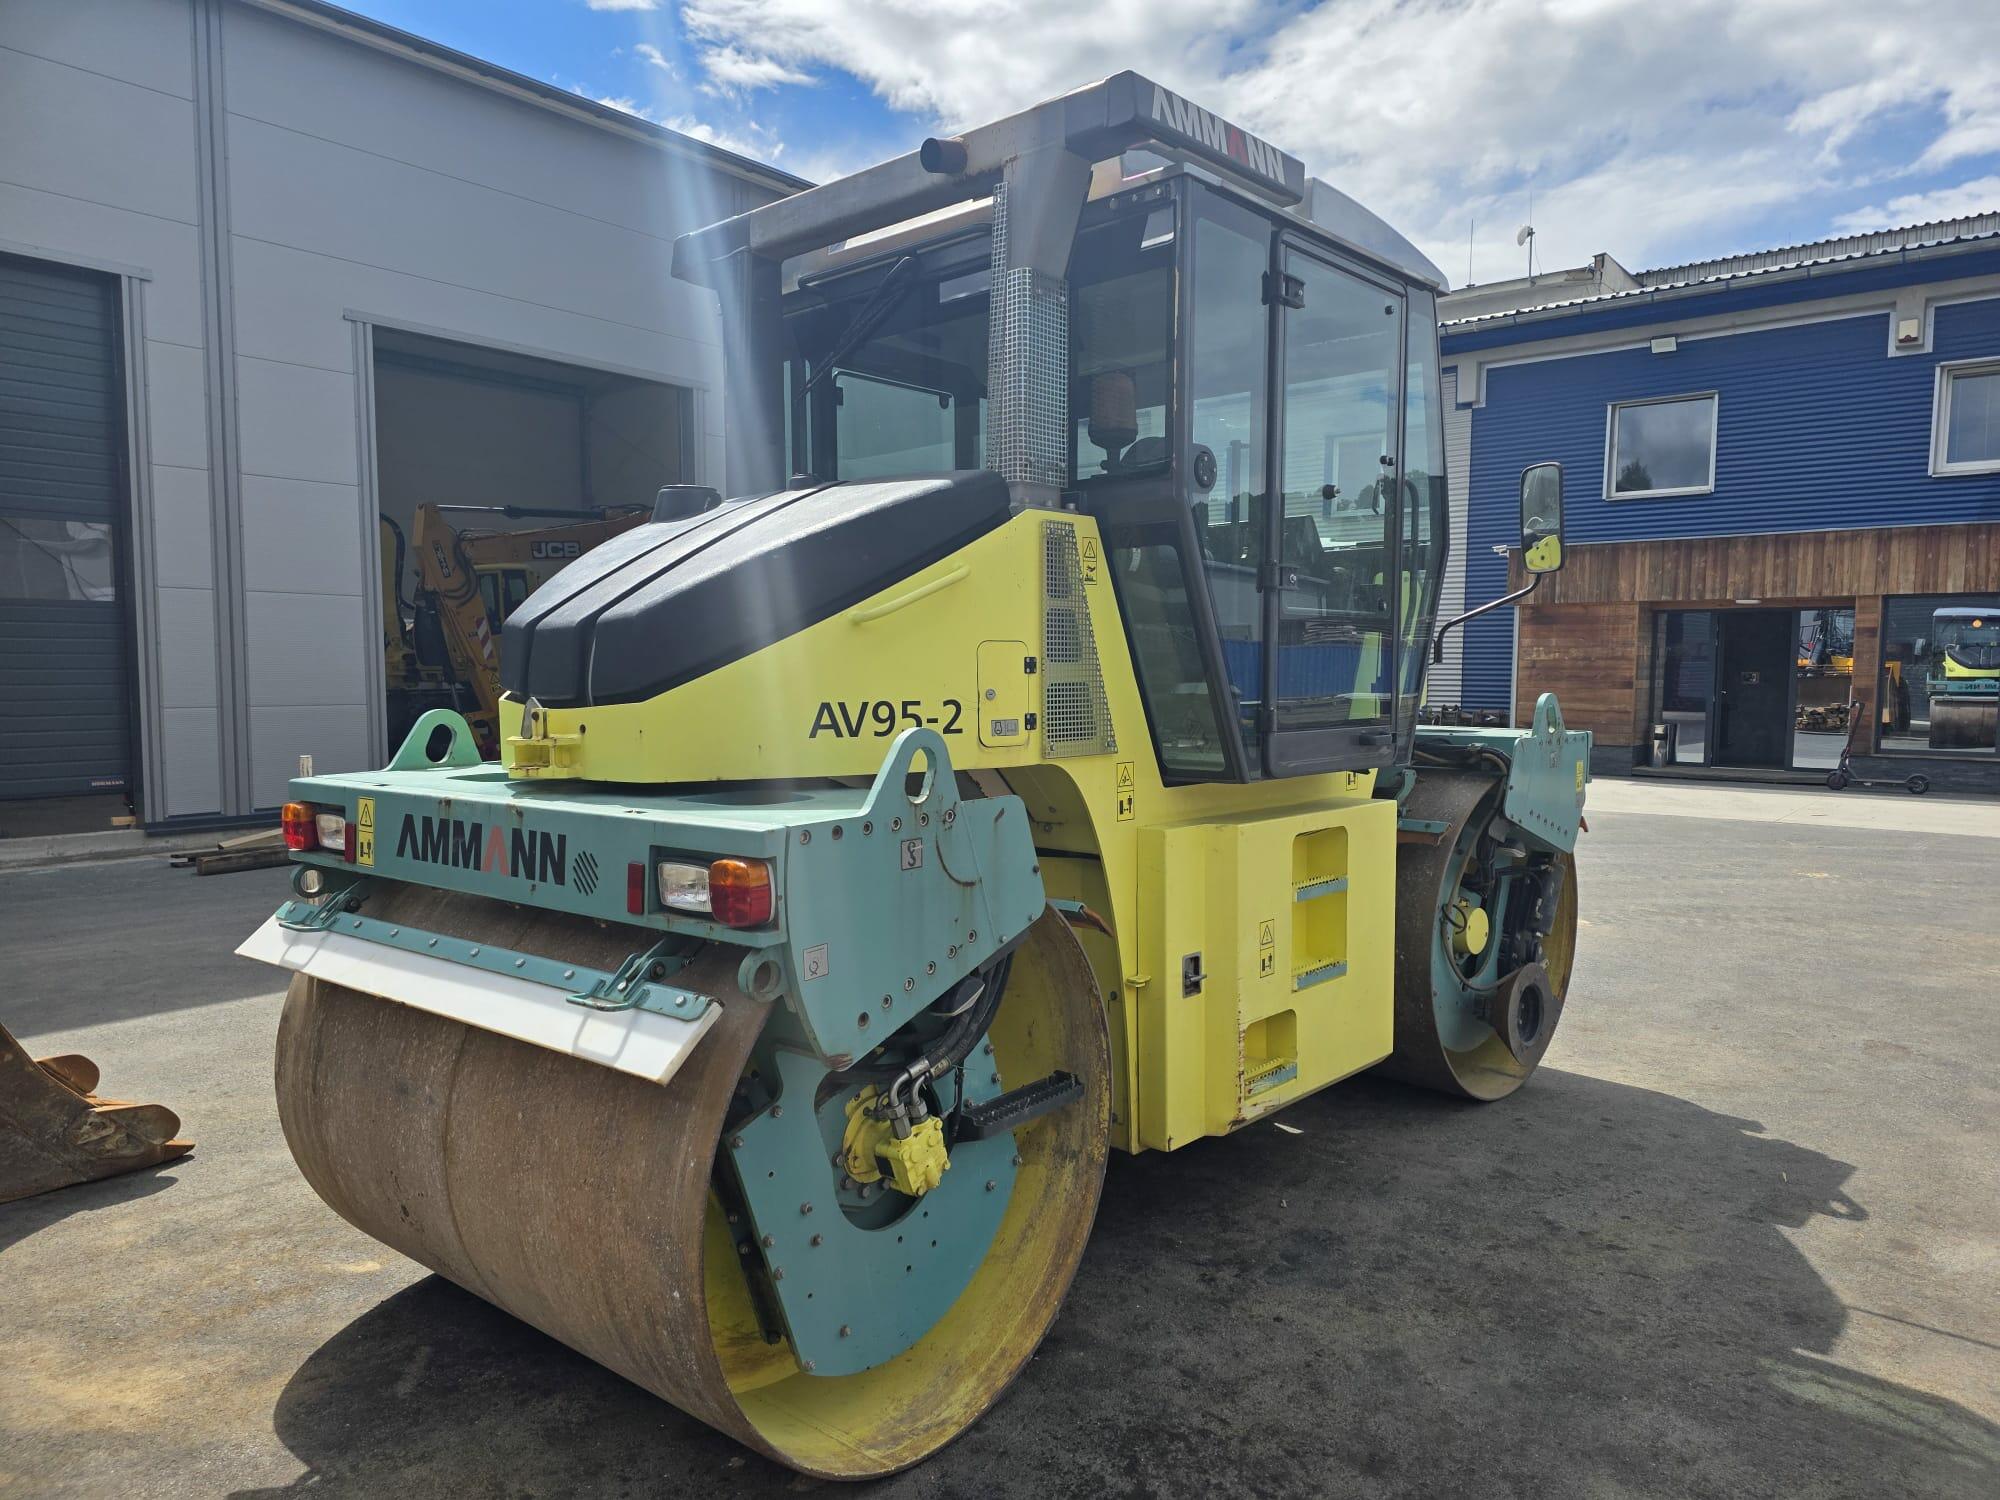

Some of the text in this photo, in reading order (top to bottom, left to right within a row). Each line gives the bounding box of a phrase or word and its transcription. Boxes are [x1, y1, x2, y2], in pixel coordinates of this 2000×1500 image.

[1152, 85, 1286, 185] AMMANN
[531, 541, 580, 559] JCB
[808, 699, 963, 738] AV95-2
[396, 813, 567, 886] AMMANN
